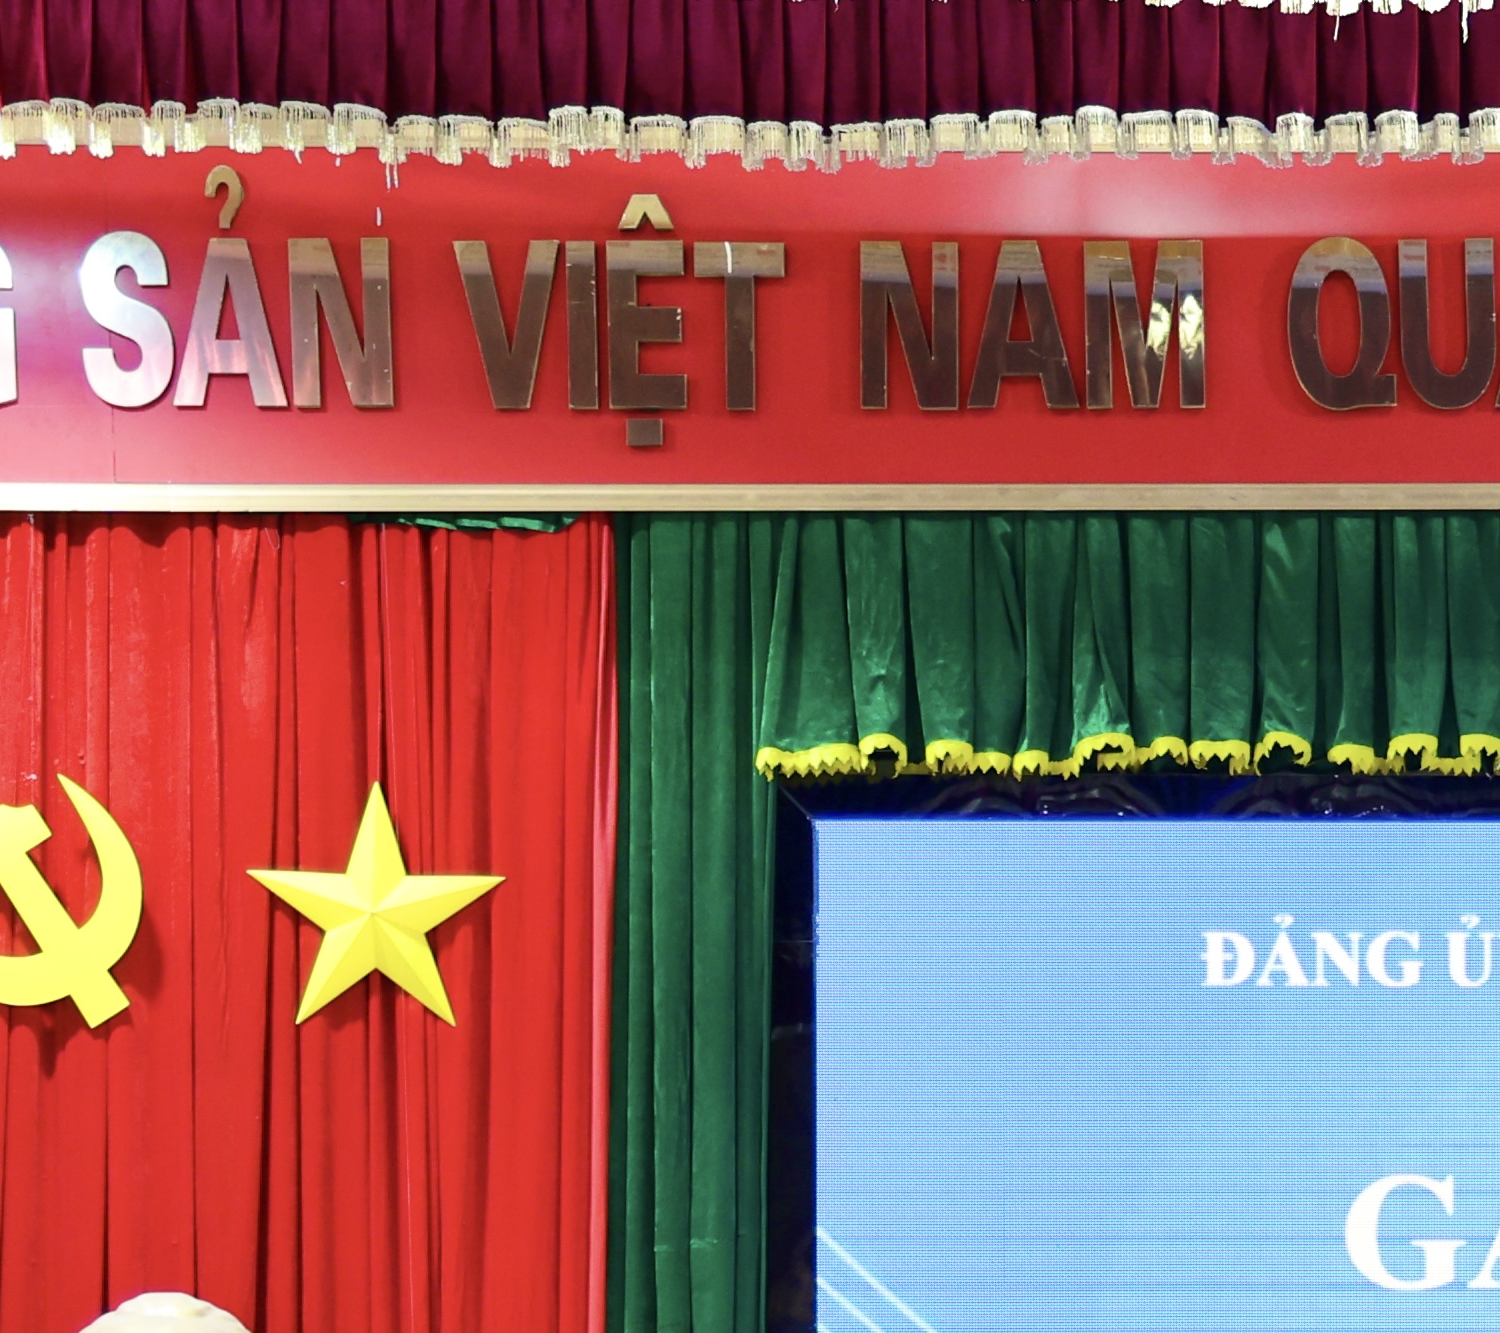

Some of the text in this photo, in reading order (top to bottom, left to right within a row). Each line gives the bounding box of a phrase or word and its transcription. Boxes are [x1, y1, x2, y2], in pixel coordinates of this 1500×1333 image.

[79, 161, 394, 411] SẢN
[451, 194, 786, 448] VIỆT
[859, 238, 1206, 412] NAM
[1200, 913, 1423, 989] ĐẢNG
